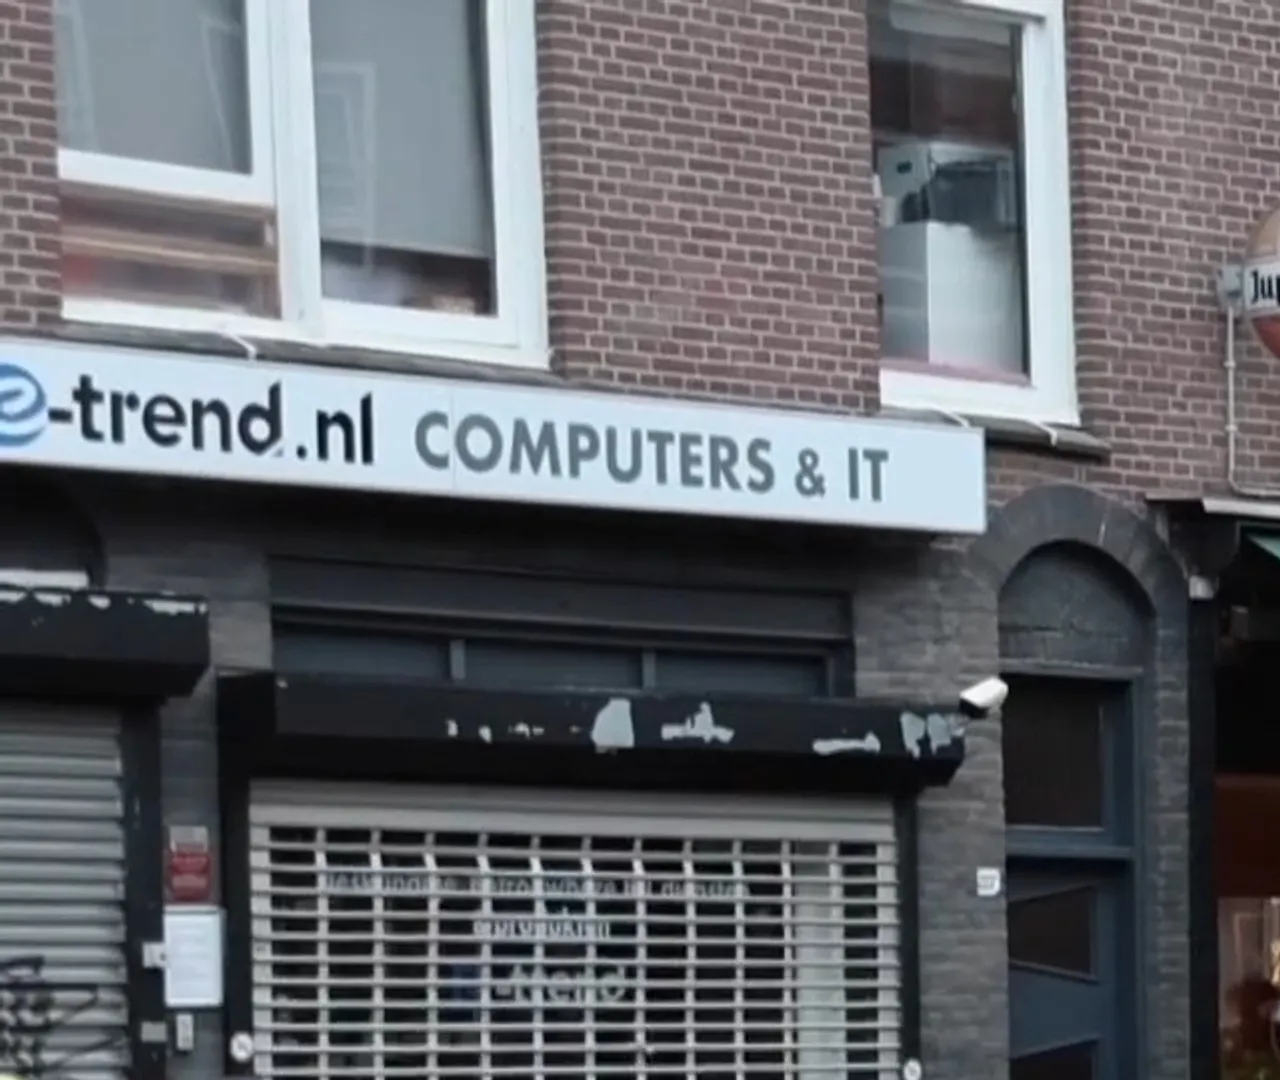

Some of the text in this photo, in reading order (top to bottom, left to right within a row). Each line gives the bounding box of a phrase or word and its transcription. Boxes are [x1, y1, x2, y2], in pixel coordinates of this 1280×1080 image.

[414, 410, 776, 494] COMPUTERS
[794, 448, 826, 499] &
[847, 447, 890, 502] IT
